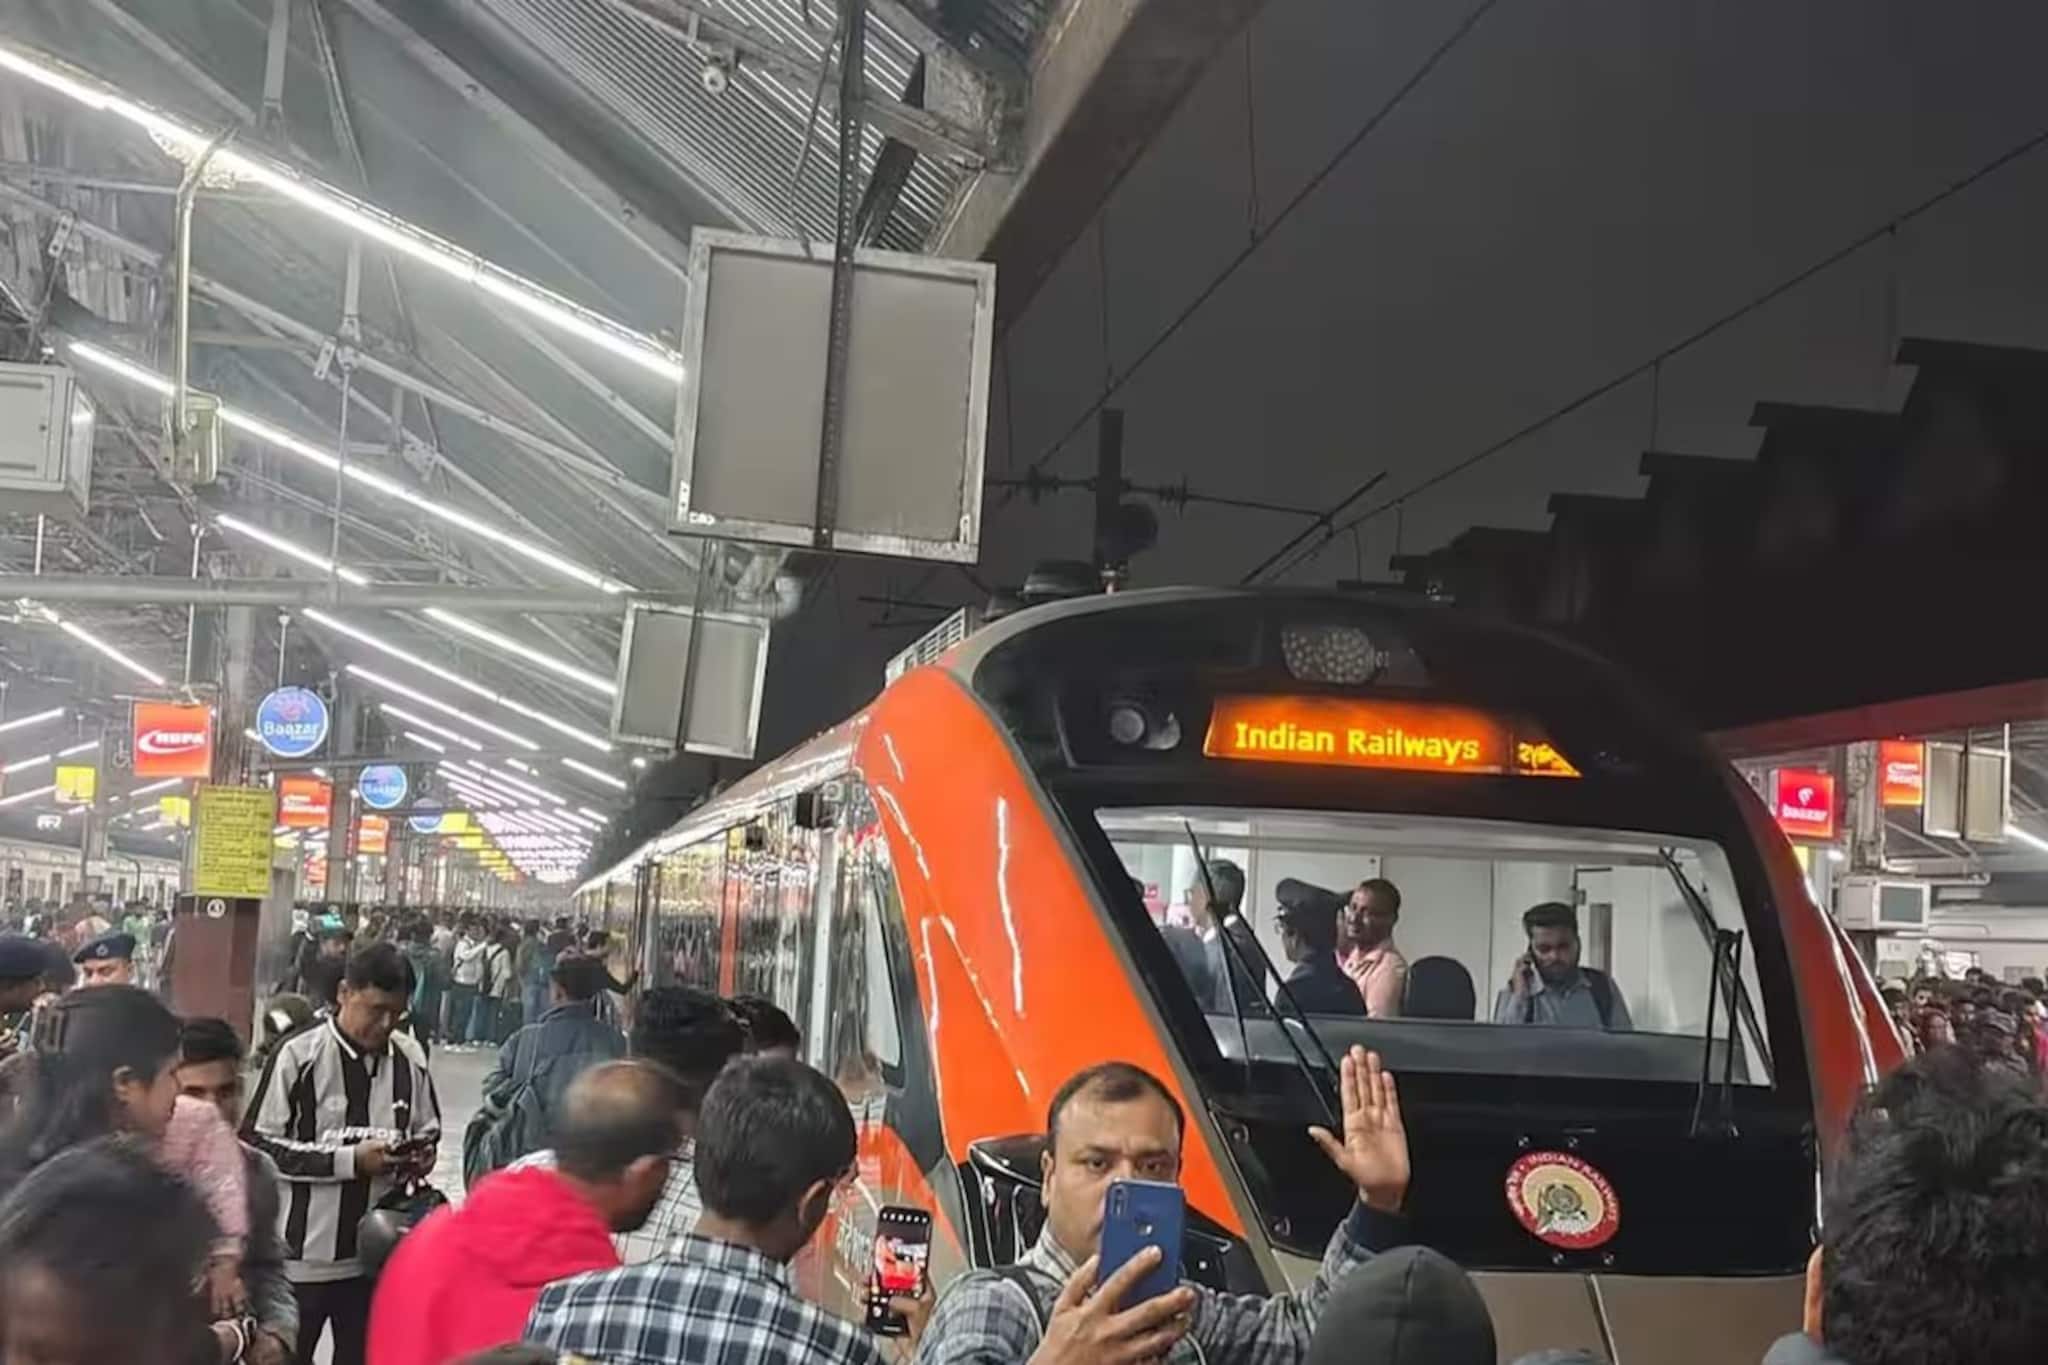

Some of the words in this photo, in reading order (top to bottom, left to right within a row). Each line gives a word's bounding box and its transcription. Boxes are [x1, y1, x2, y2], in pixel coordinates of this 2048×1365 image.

[1235, 721, 1335, 753] Indian
[1347, 728, 1480, 765] Railways
[1528, 1153, 1580, 1168] INDIAN
